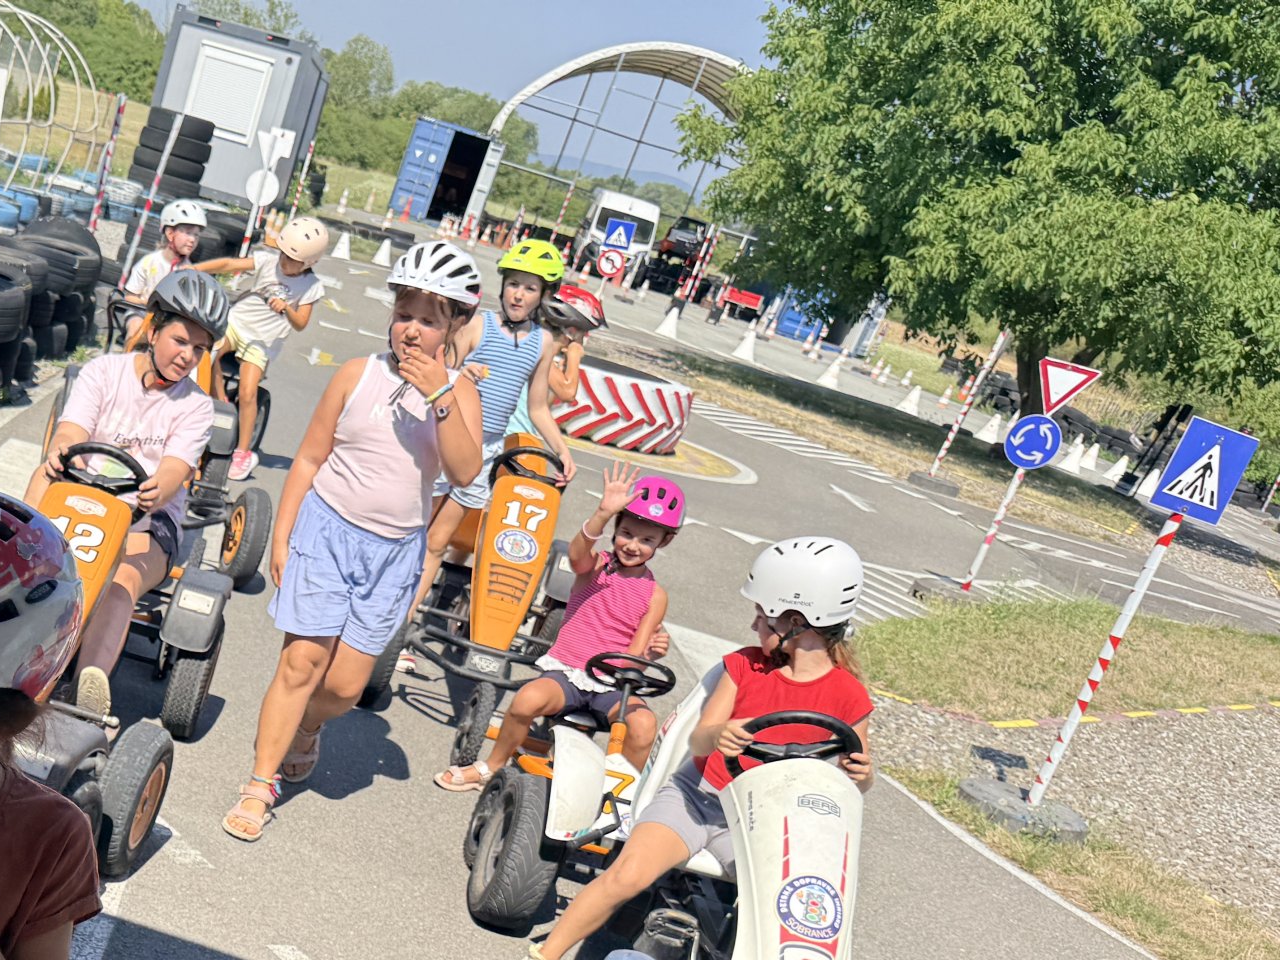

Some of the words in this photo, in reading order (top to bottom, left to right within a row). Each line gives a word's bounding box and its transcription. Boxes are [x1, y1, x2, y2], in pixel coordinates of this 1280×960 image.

[113, 432, 166, 447] Everythin
[501, 500, 549, 532] 17
[49, 515, 106, 564] 12
[799, 797, 840, 816] BERG
[785, 917, 834, 939] SOBRANCE
